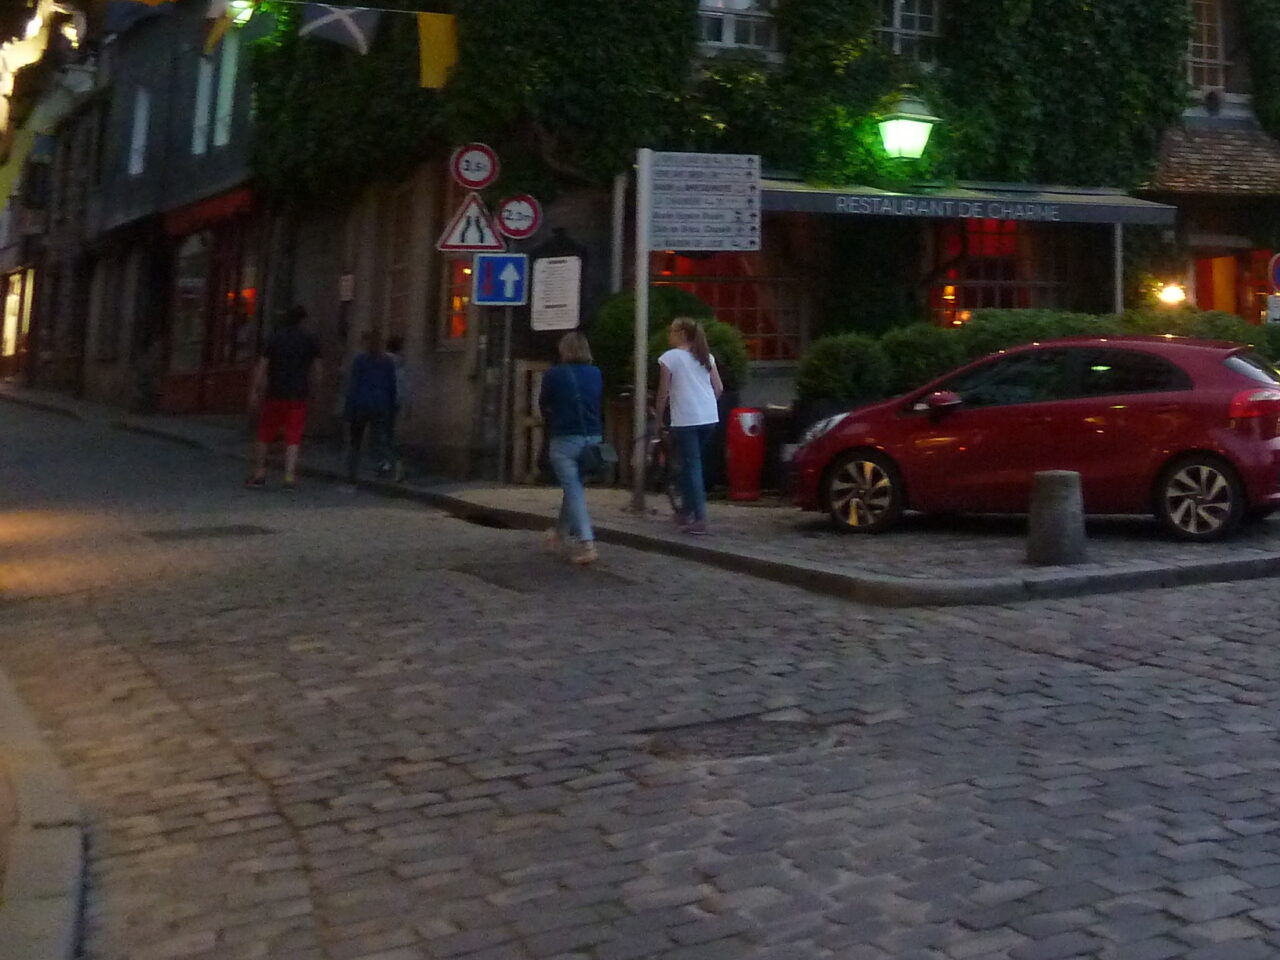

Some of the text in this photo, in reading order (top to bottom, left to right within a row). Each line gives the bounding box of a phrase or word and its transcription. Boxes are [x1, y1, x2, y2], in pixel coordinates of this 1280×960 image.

[835, 196, 1061, 222] RESTAURANT DE CHARME
